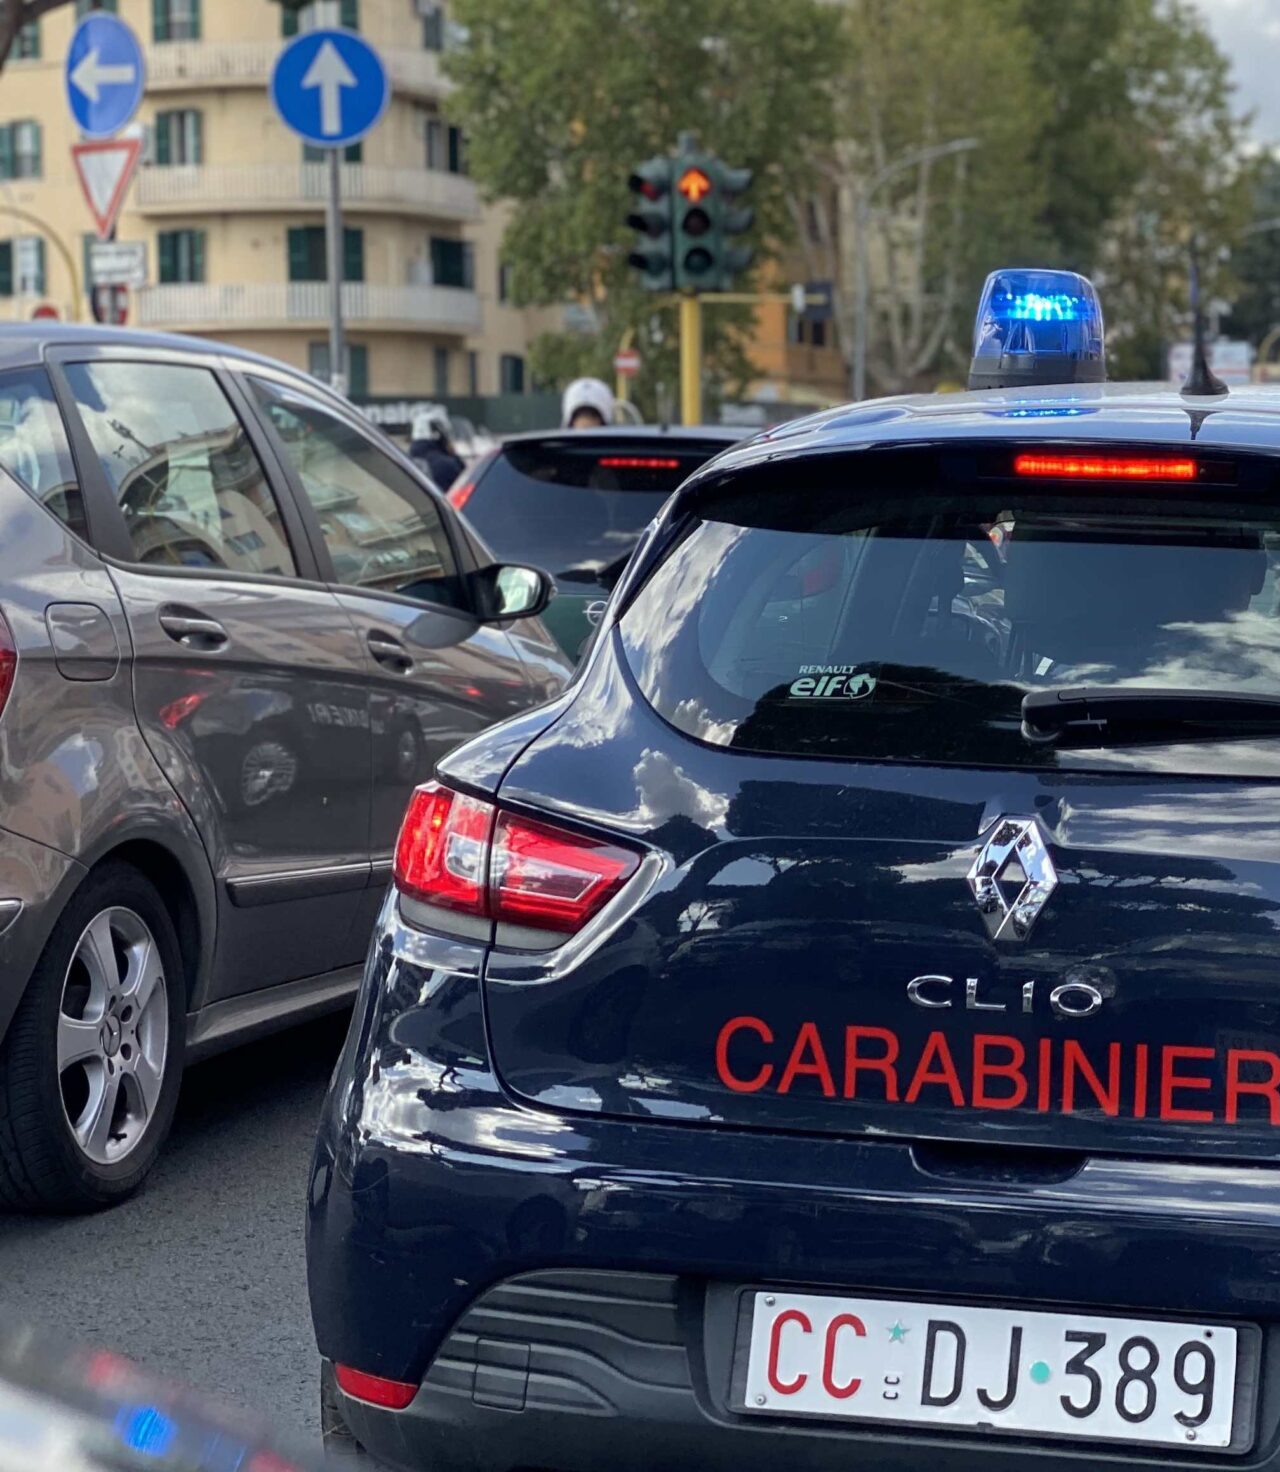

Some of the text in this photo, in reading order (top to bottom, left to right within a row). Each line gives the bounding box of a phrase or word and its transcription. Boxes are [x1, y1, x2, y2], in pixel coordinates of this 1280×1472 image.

[799, 665, 857, 674] RENAULT
[906, 974, 1103, 1015] CLIO
[767, 1308, 1217, 1428] CC DJ 389
